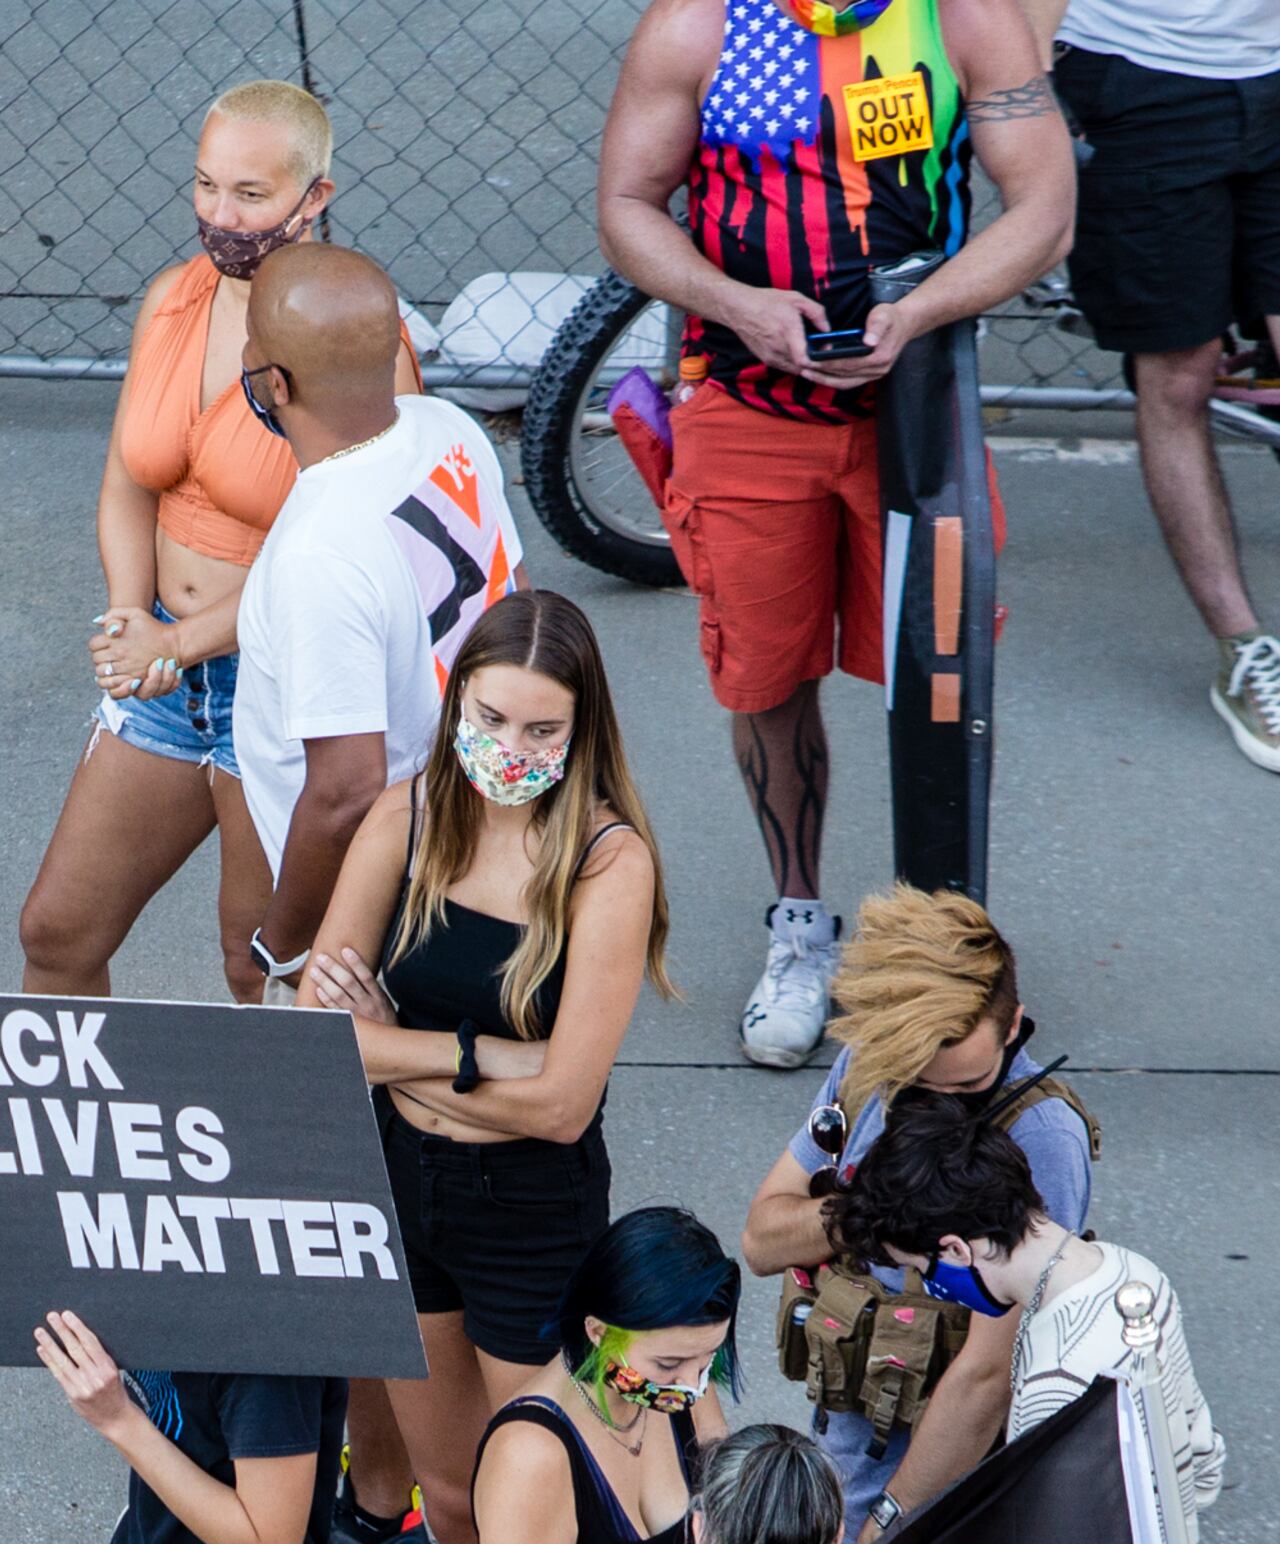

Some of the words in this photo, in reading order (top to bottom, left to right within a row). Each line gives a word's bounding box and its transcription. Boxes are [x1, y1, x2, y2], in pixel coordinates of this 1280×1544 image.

[859, 93, 914, 124] OUT
[858, 116, 924, 150] NOW
[57, 1191, 399, 1281] MATTER
